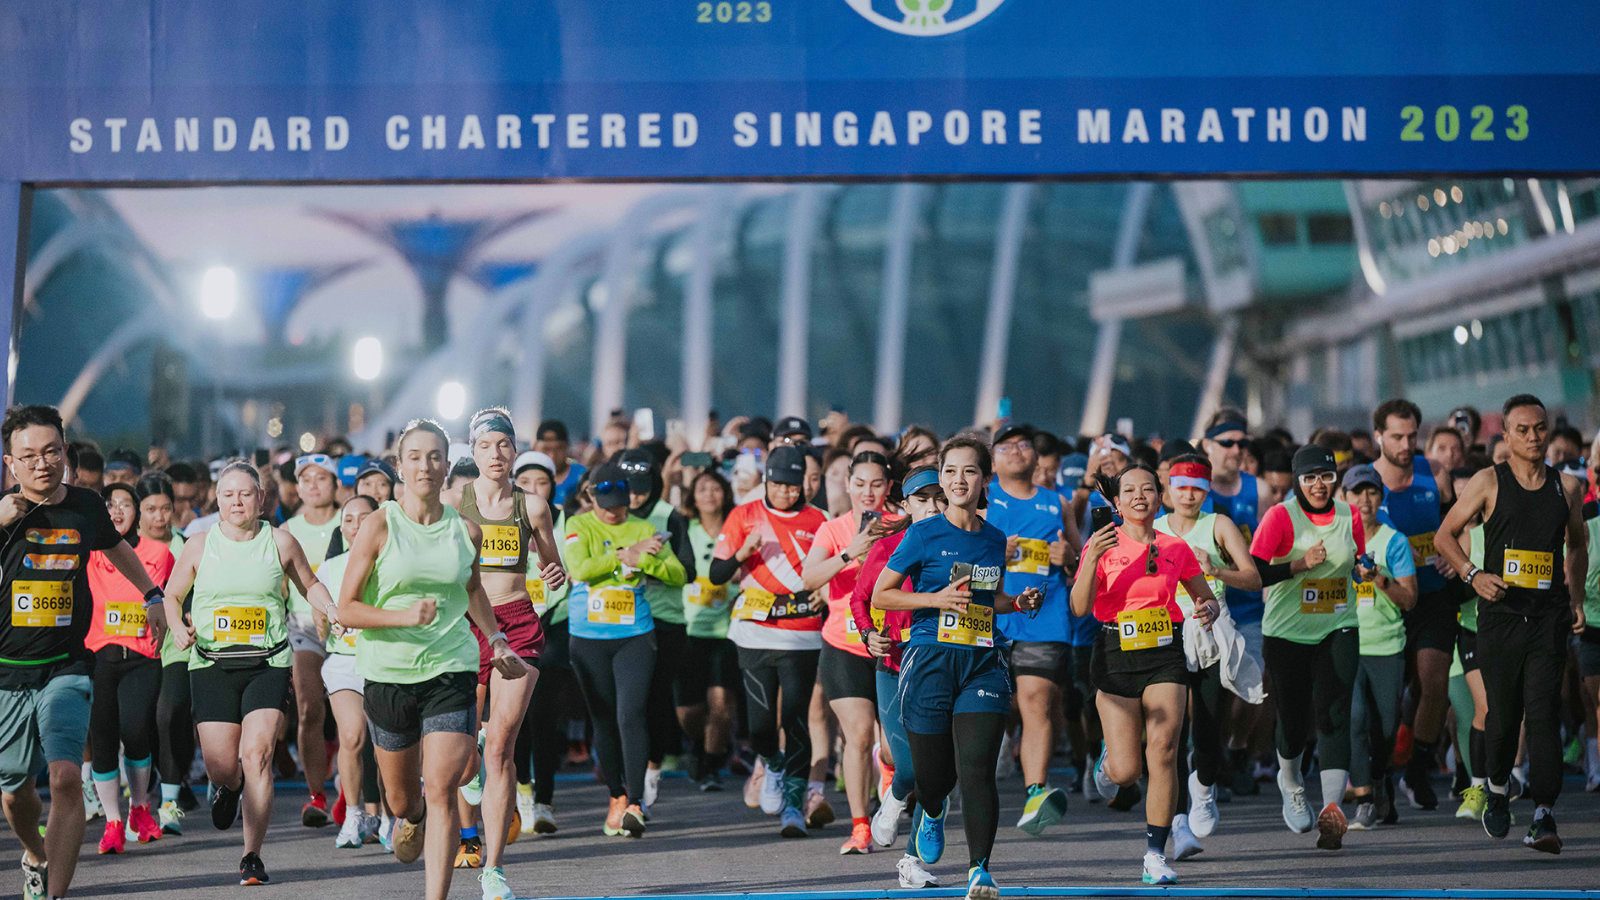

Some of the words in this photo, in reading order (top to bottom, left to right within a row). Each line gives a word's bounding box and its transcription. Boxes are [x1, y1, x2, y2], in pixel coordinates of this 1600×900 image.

[697, 2, 771, 23] 2023
[69, 116, 349, 153] STANDARD
[386, 113, 698, 150] CHARTERED
[734, 110, 1042, 147] SINGAPORE
[1078, 107, 1366, 143] MARATHON
[1400, 105, 1530, 141] 2023
[482, 538, 519, 551] 41363
[1508, 562, 1518, 573] D
[1520, 563, 1552, 575] 43109
[1306, 591, 1316, 602] D
[1318, 589, 1347, 601] 41420
[17, 596, 29, 610] C
[32, 597, 72, 610] 36699
[592, 600, 601, 609] D
[604, 601, 634, 612] 44077
[109, 612, 118, 623] D
[120, 614, 147, 625] 4232
[218, 618, 228, 629] D
[230, 619, 265, 631] 42919
[944, 614, 956, 627] D
[958, 617, 992, 633] 43938
[1124, 624, 1134, 636] D
[1137, 619, 1170, 634] 42431
